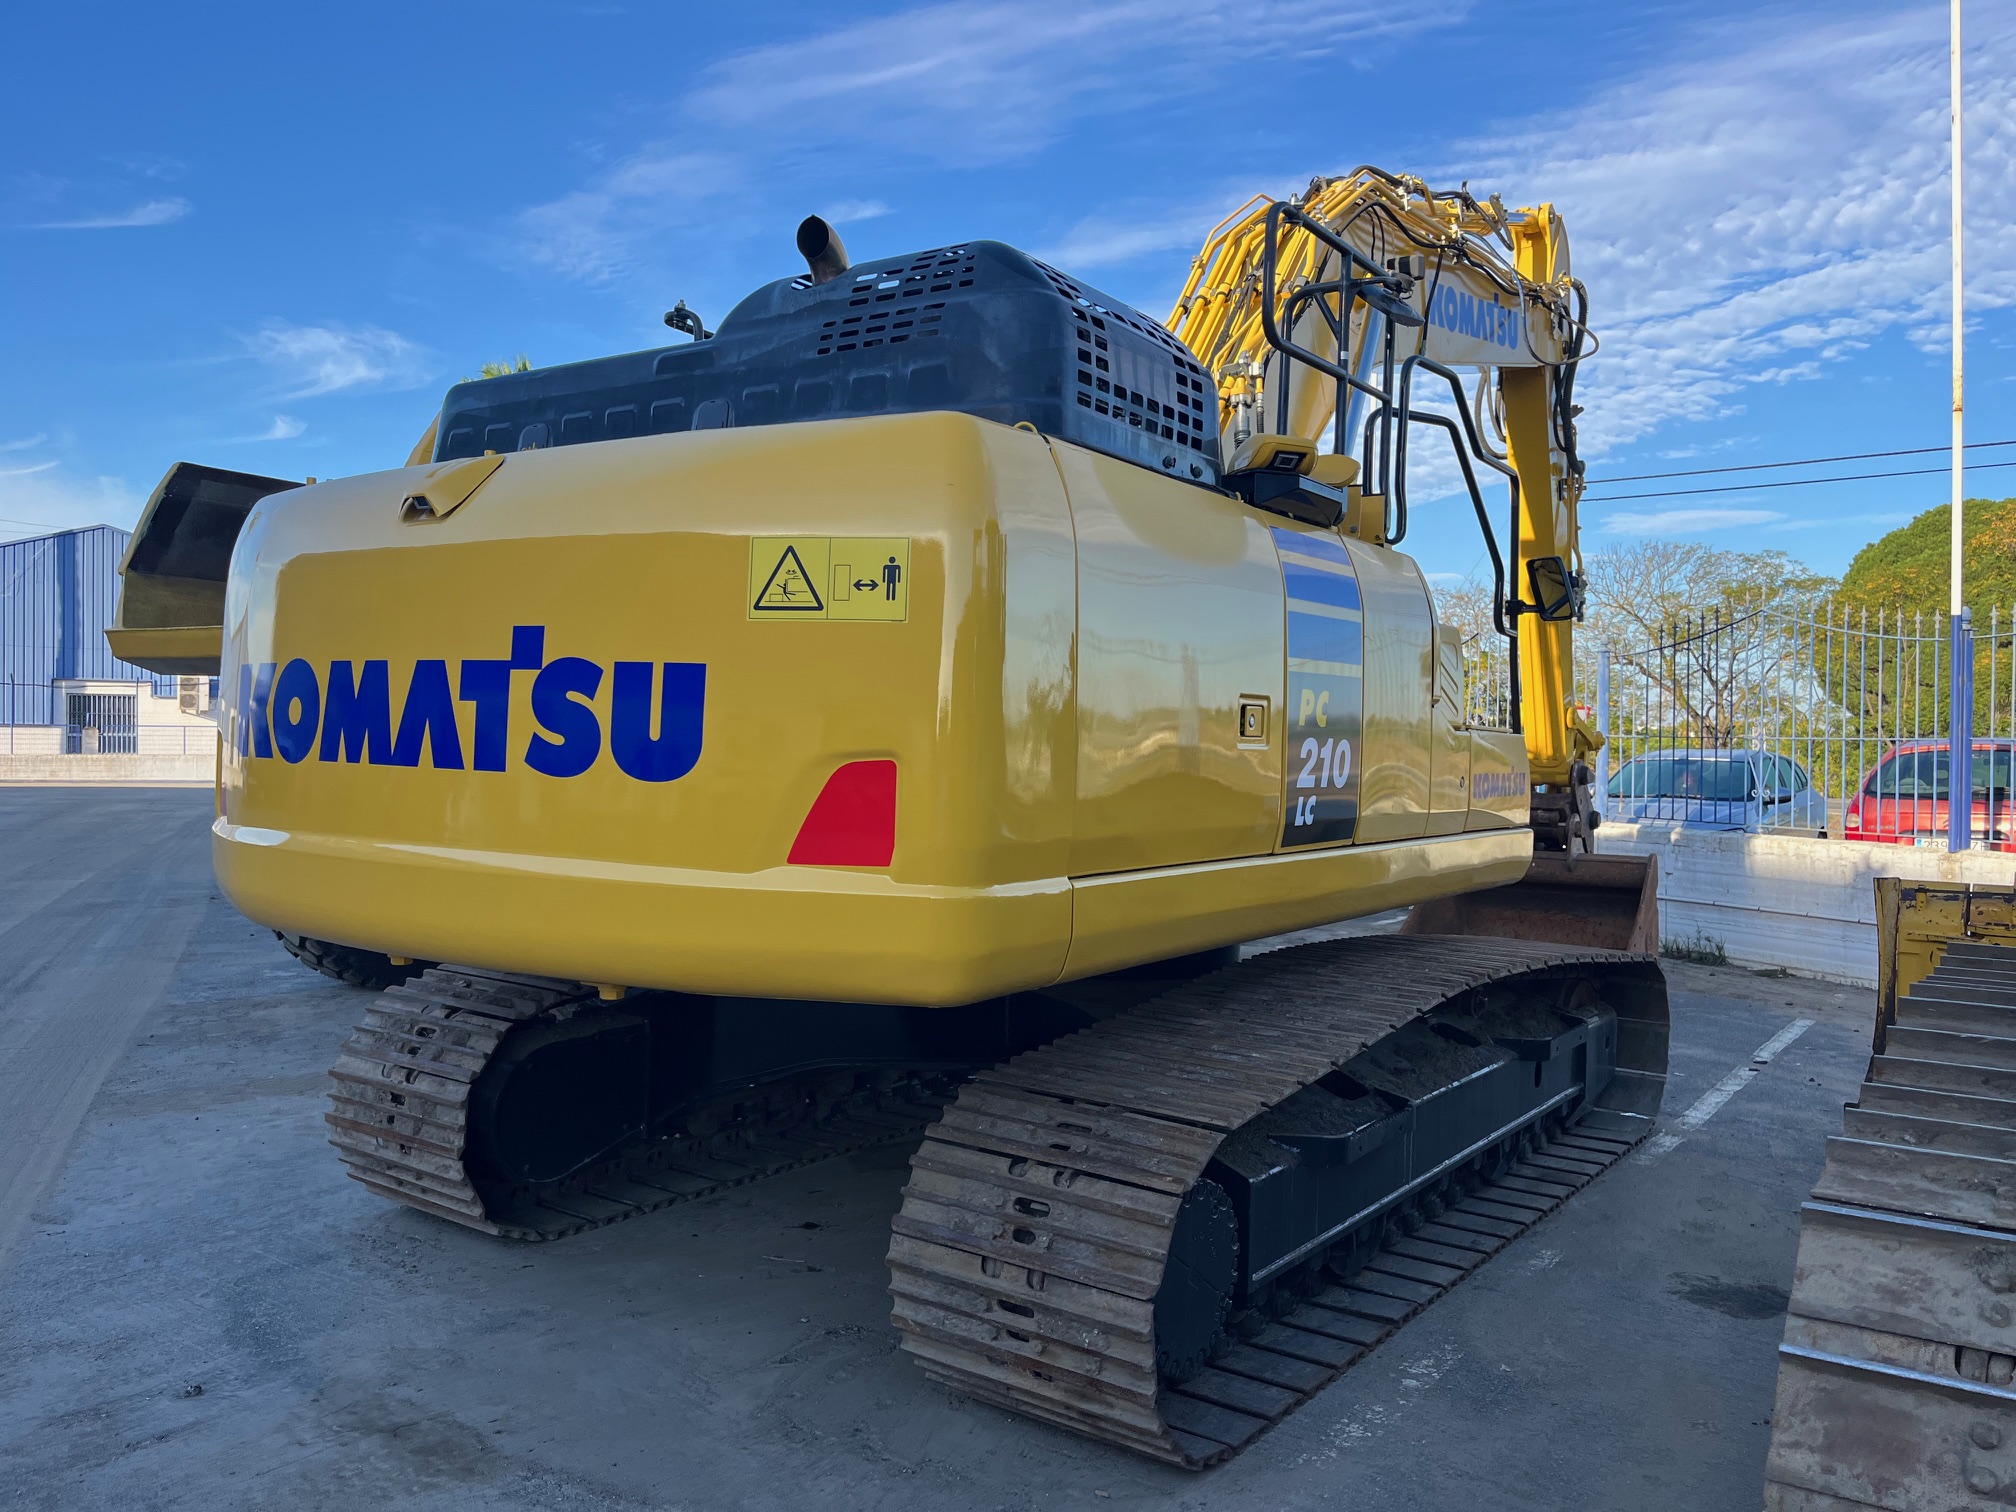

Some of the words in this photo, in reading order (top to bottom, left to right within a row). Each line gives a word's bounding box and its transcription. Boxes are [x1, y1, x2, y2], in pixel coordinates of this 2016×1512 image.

[1429, 280, 1519, 350] KOMATSU
[241, 626, 707, 783] KOMATSU
[1299, 688, 1330, 728] PC
[1296, 737, 1351, 789] 210
[1472, 766, 1526, 799] KOMATSU
[1294, 795, 1317, 827] LC
